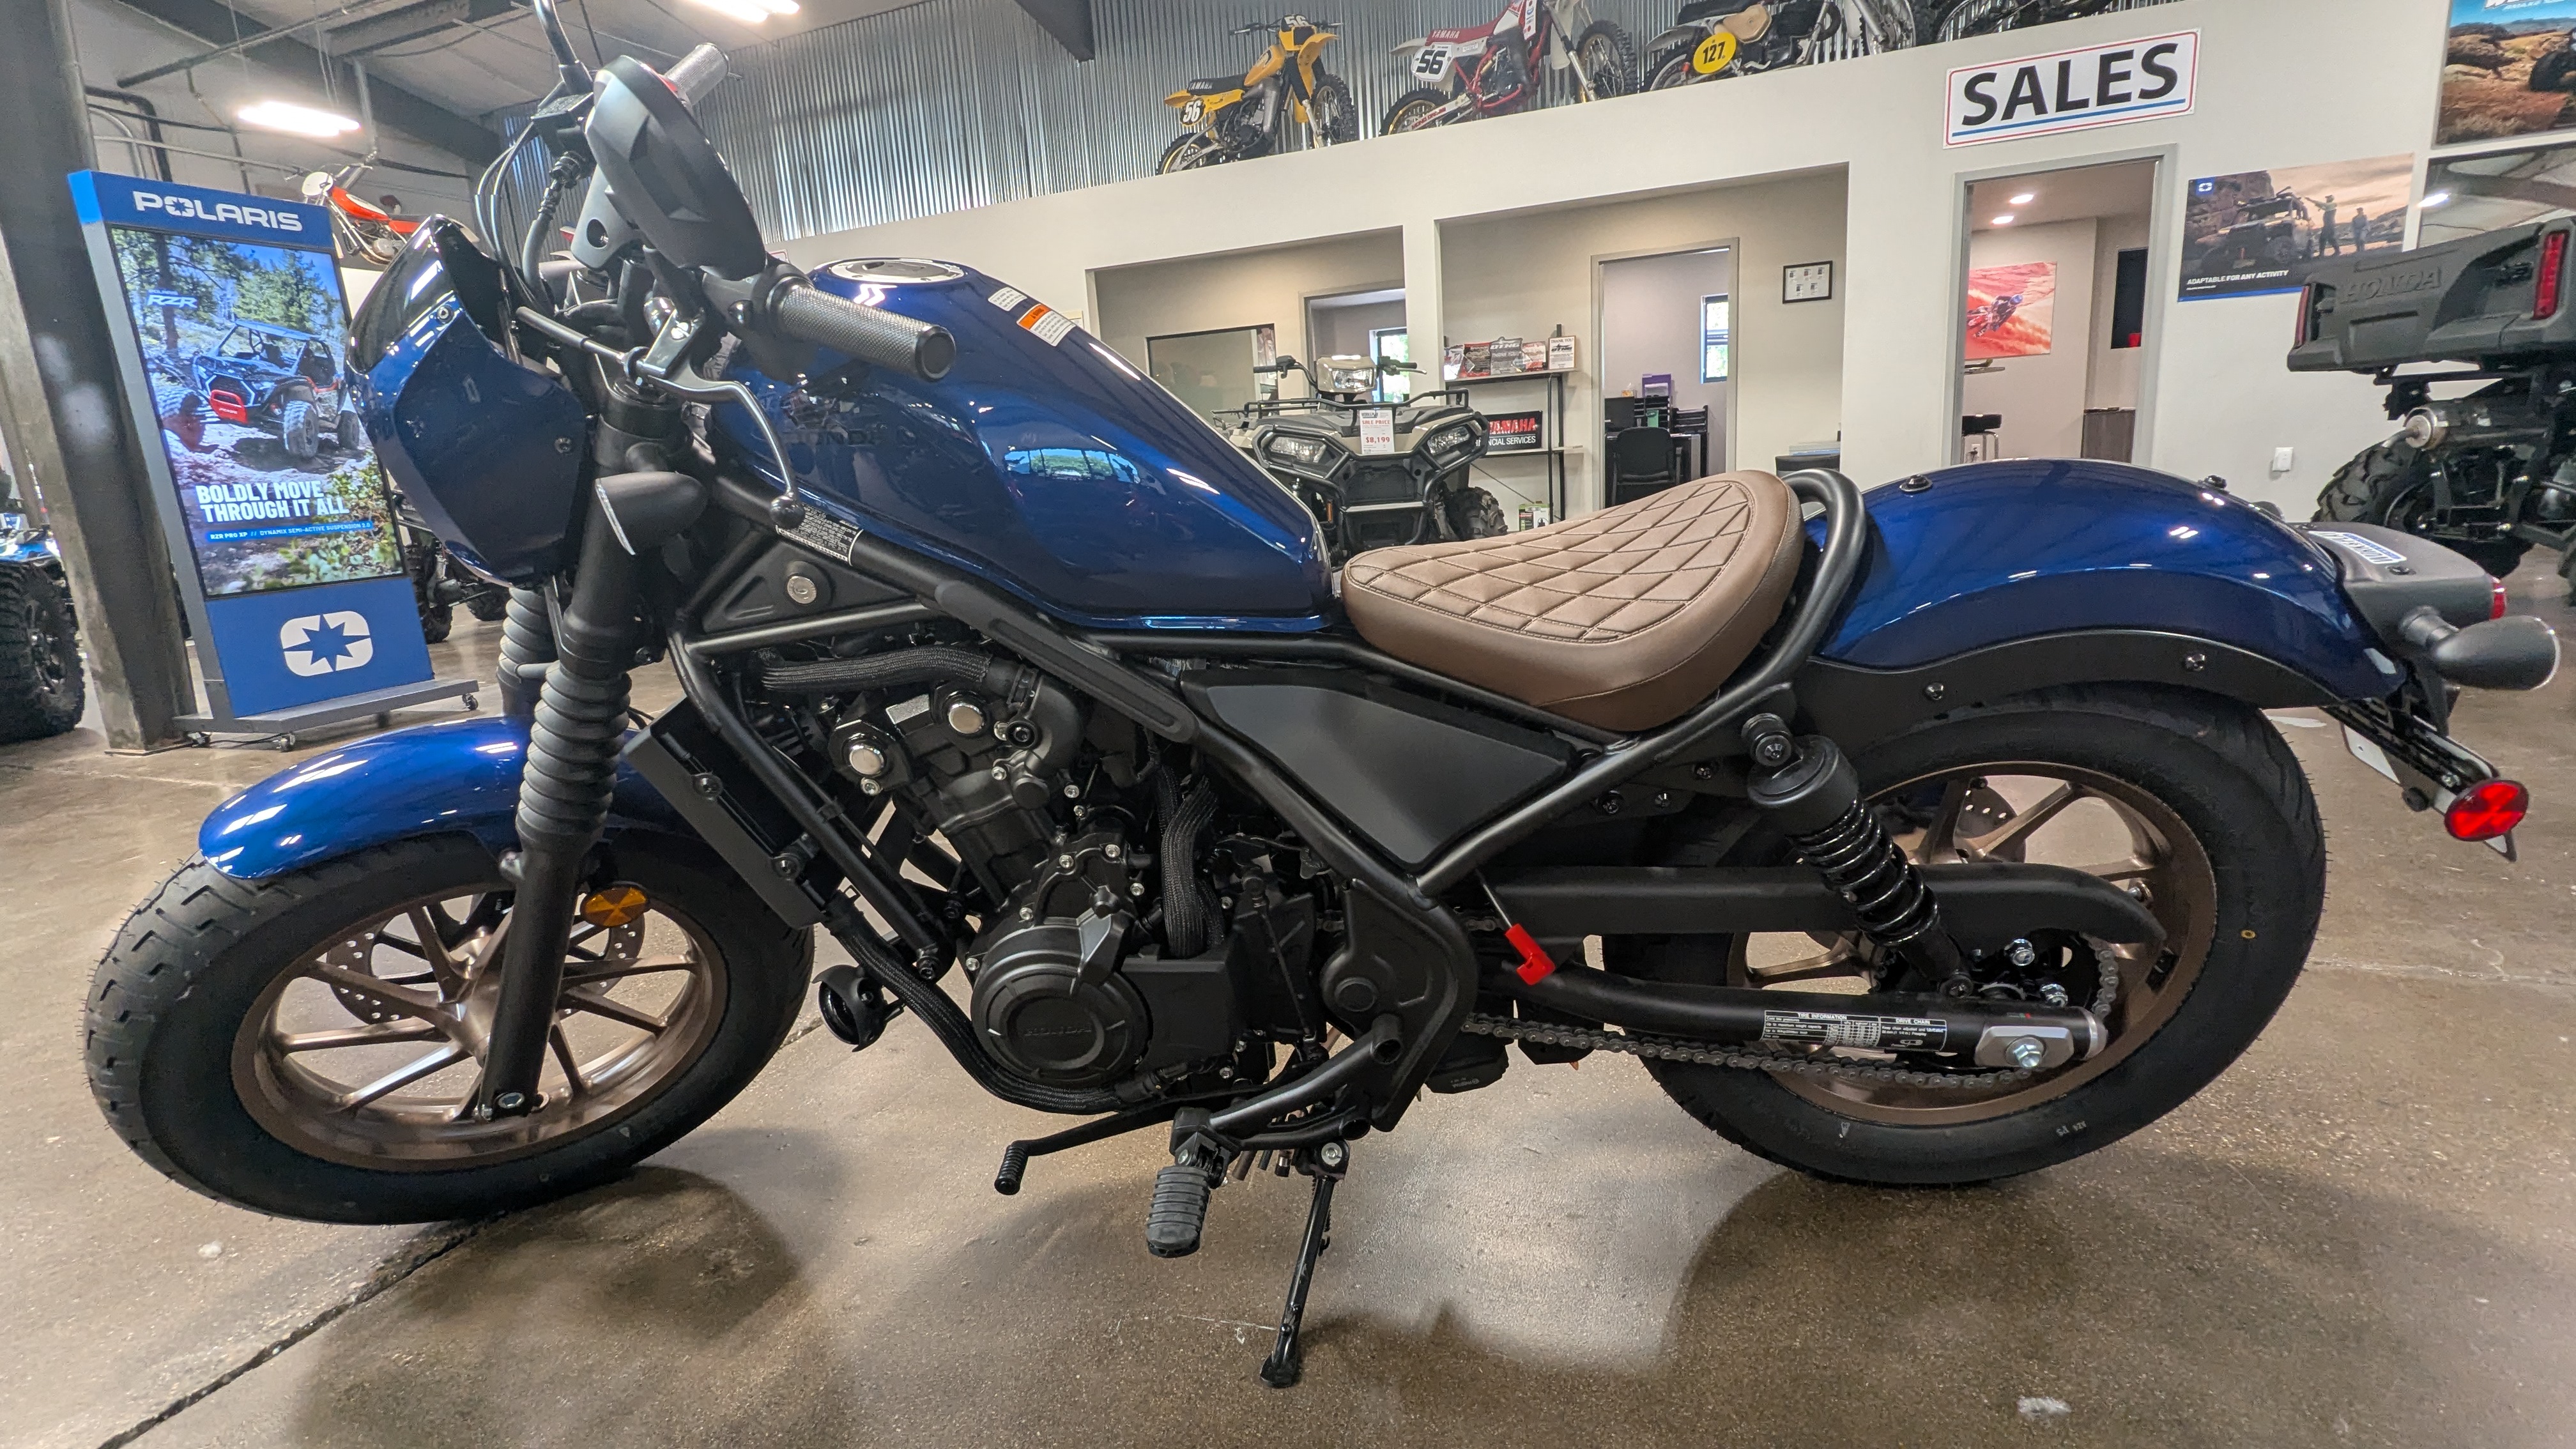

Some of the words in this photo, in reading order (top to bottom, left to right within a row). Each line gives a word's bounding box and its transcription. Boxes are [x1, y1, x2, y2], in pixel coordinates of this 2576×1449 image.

[1432, 30, 1460, 39] YAMAHA
[1416, 49, 1447, 75] 56
[1703, 41, 1726, 64] 127
[1961, 42, 2179, 126] SALES
[1183, 98, 1202, 123] 56
[133, 191, 303, 231] POLARIS
[2186, 276, 2226, 285] ADAPTABLE
[2257, 270, 2289, 278] ACTIVITY
[147, 295, 199, 309] RZR
[1506, 436, 1536, 445] SERVICES
[195, 482, 269, 503] BOLDLY
[273, 480, 325, 500] MOVE
[200, 500, 290, 523] THROUGH
[292, 499, 310, 517] IT
[316, 497, 350, 516] ALL
[288, 526, 325, 534] SEMI-ACTIVE
